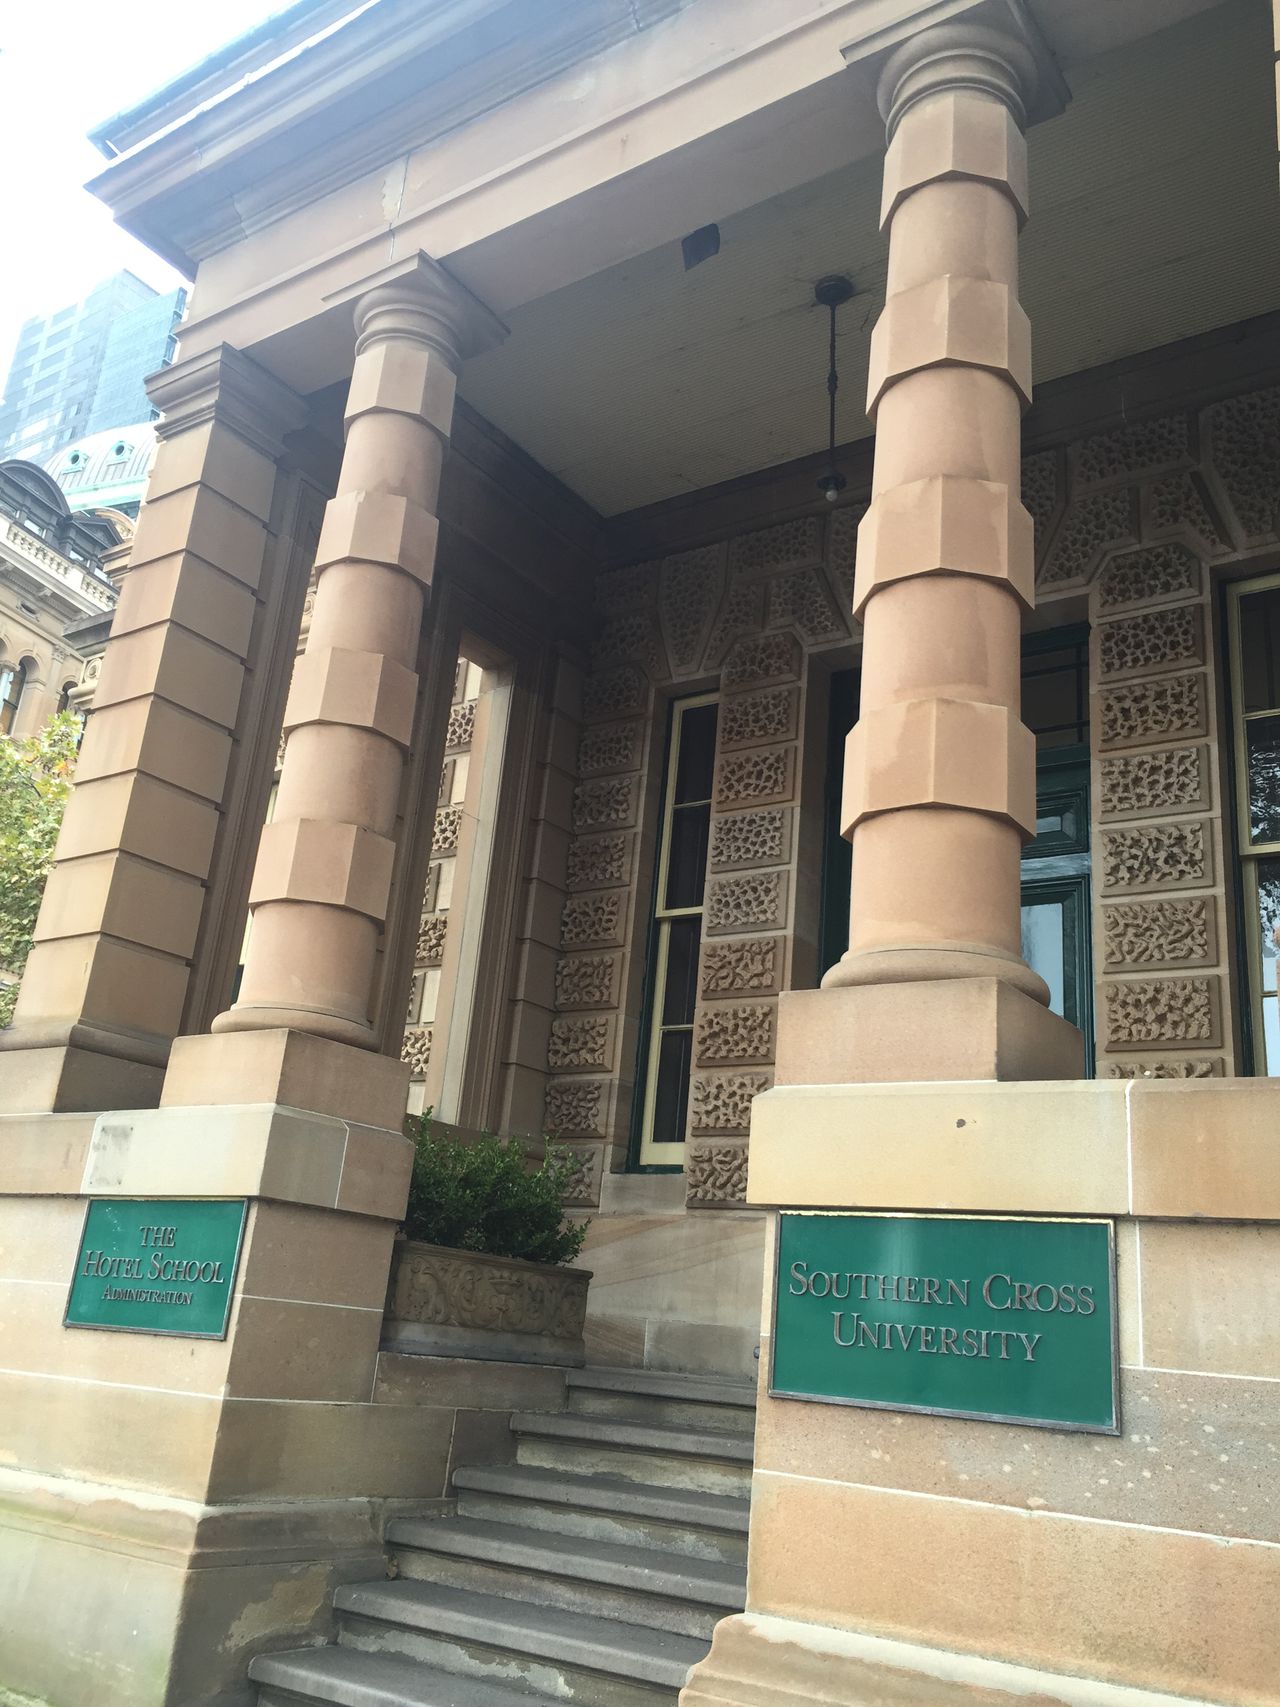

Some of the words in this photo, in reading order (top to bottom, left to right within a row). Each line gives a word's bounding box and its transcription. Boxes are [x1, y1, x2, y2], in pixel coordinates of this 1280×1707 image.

[139, 1225, 178, 1248] THE
[81, 1249, 143, 1280] HOTEL
[147, 1251, 225, 1284] SCHOOL
[101, 1284, 193, 1305] ADMINISTRATION
[788, 1261, 971, 1307] SOUTHERN
[982, 1273, 1096, 1316] CROSS
[831, 1311, 1042, 1363] UNIVERSITY
